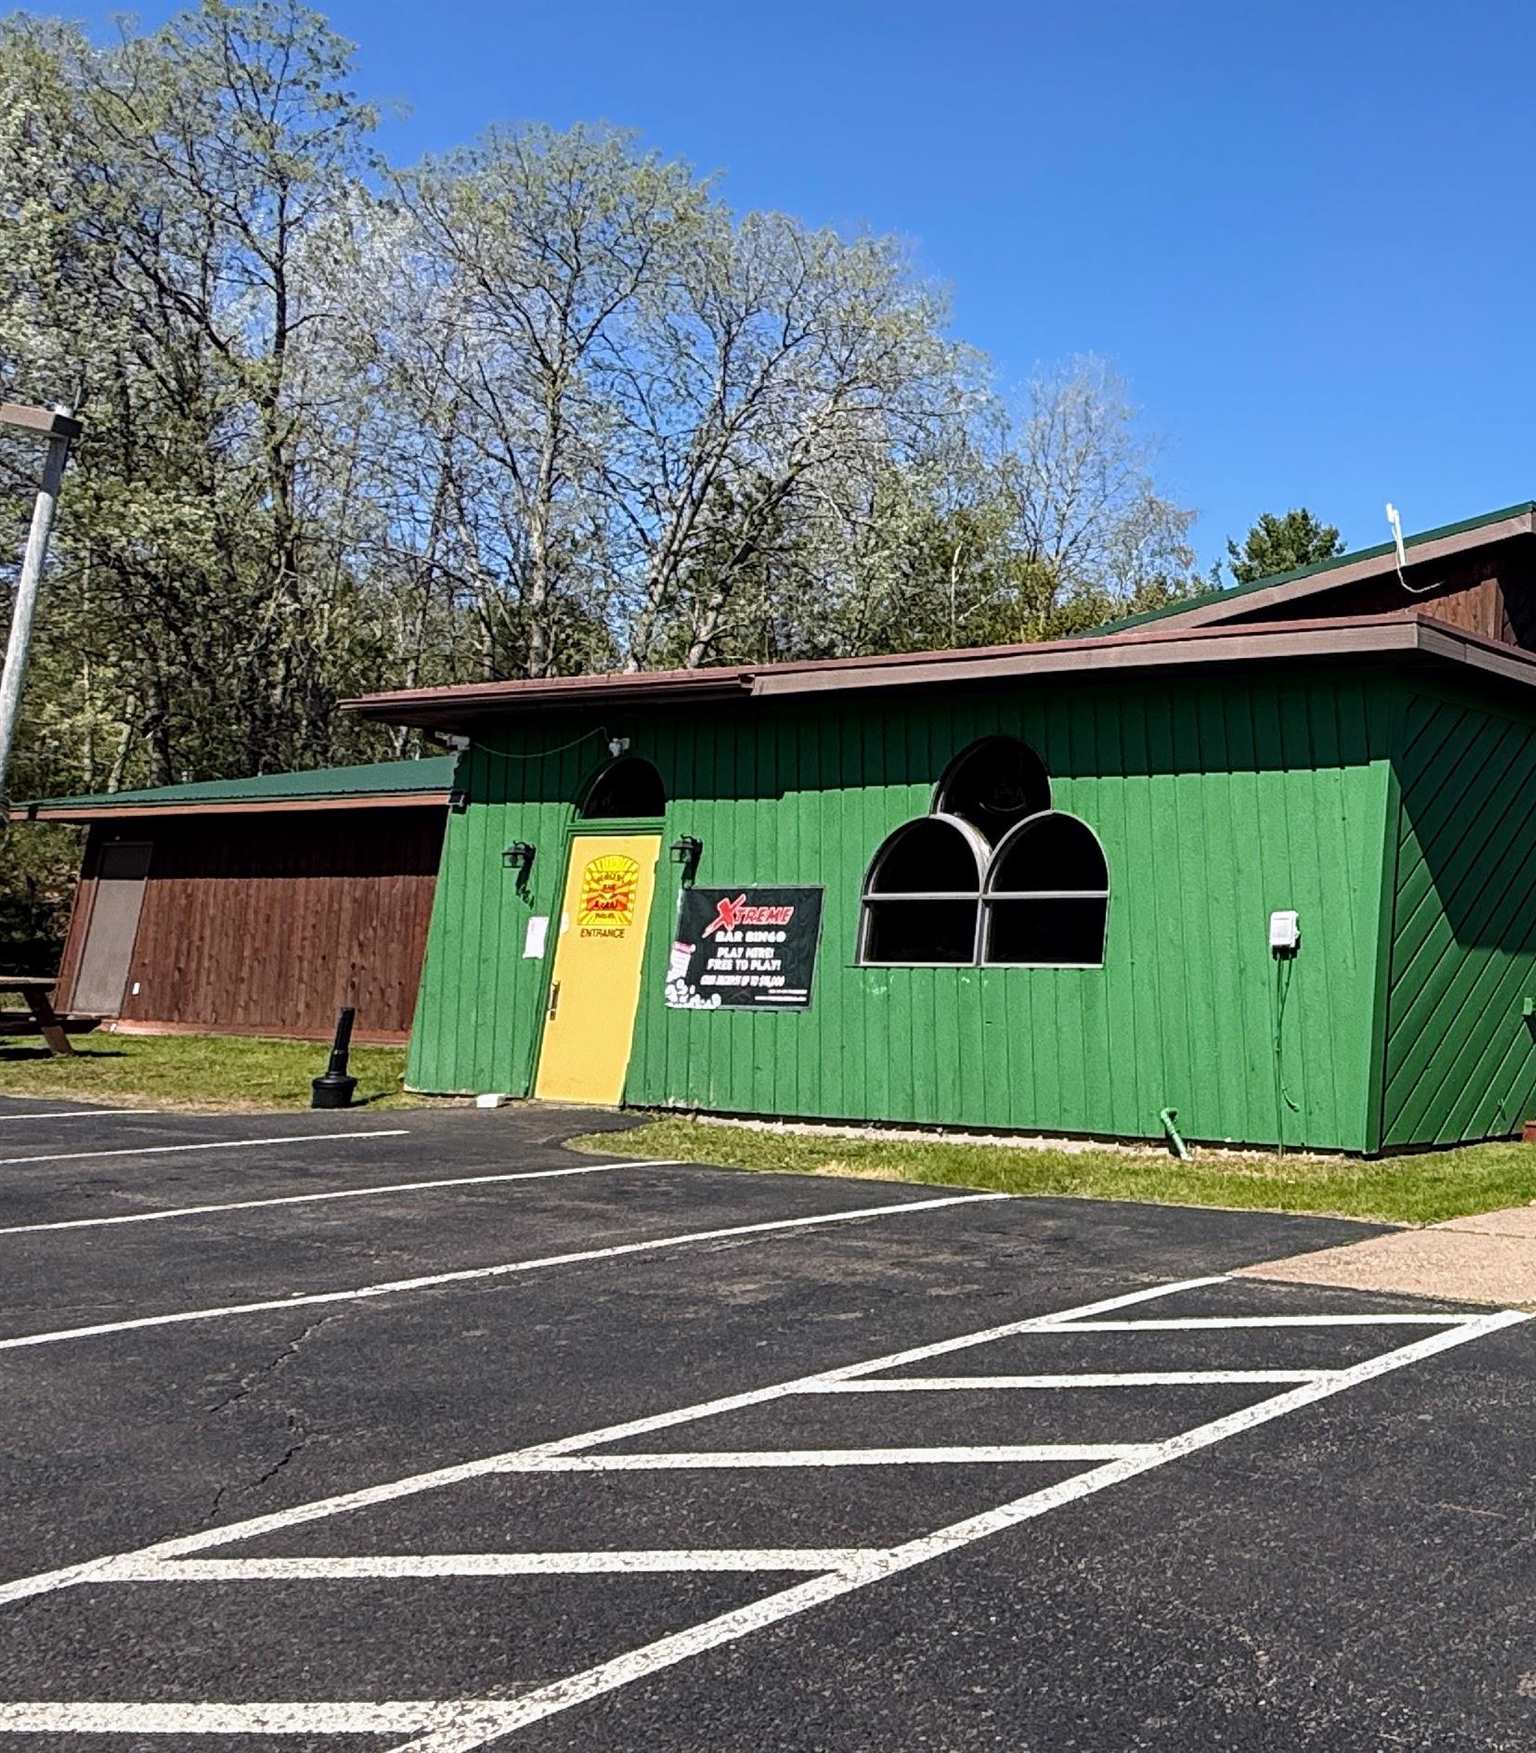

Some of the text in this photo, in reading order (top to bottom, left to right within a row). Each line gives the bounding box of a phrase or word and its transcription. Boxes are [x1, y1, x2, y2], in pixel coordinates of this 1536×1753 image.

[580, 928, 625, 938] ENTRANCE
[715, 931, 787, 942] BAR BINGO
[717, 947, 744, 958] PLAY
[735, 959, 749, 971] TO
[750, 959, 782, 971] PLAY!
